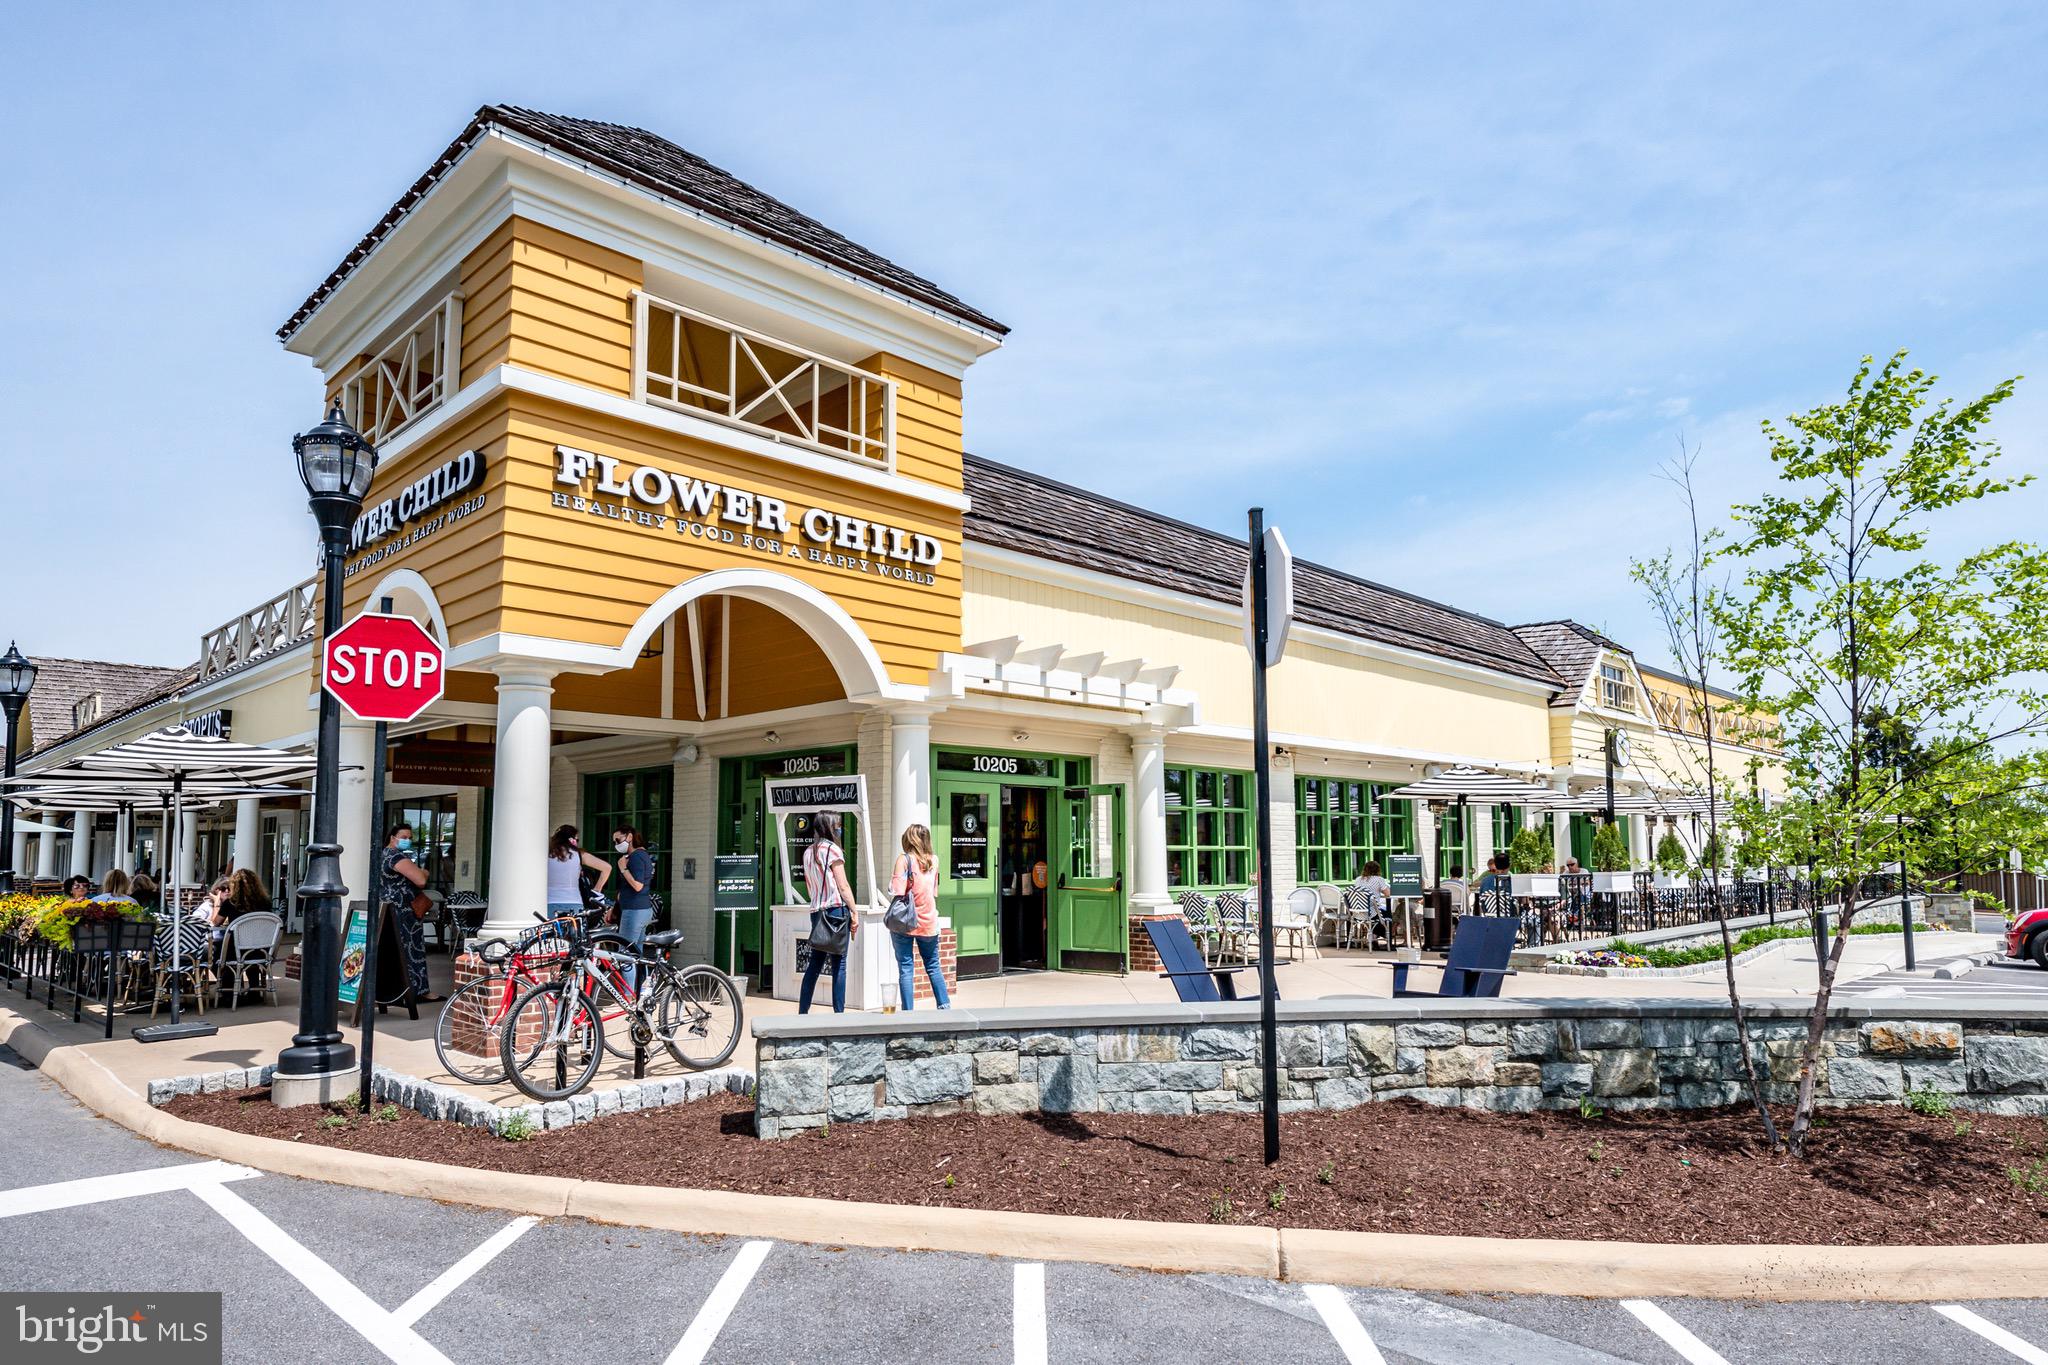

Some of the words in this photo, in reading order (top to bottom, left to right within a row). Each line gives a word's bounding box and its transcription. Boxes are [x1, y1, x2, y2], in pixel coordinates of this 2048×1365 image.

[398, 450, 477, 522] CHILD
[556, 445, 791, 533] FLOWER
[802, 508, 943, 566] CHILD
[361, 549, 384, 568] FOOD
[385, 540, 402, 555] FOR
[404, 534, 411, 547] A
[412, 517, 445, 542] HAPPY
[447, 494, 486, 524] WORLD
[552, 492, 667, 529] HEALTHY
[677, 519, 735, 543] FOOD
[743, 533, 781, 553] FOR
[788, 545, 801, 559] A
[808, 548, 869, 572] HAPPY
[876, 562, 936, 586] WORLD
[330, 644, 439, 689] STOP
[180, 709, 221, 737] TOPUS
[783, 757, 820, 774] 10205
[972, 755, 1018, 774] 10205
